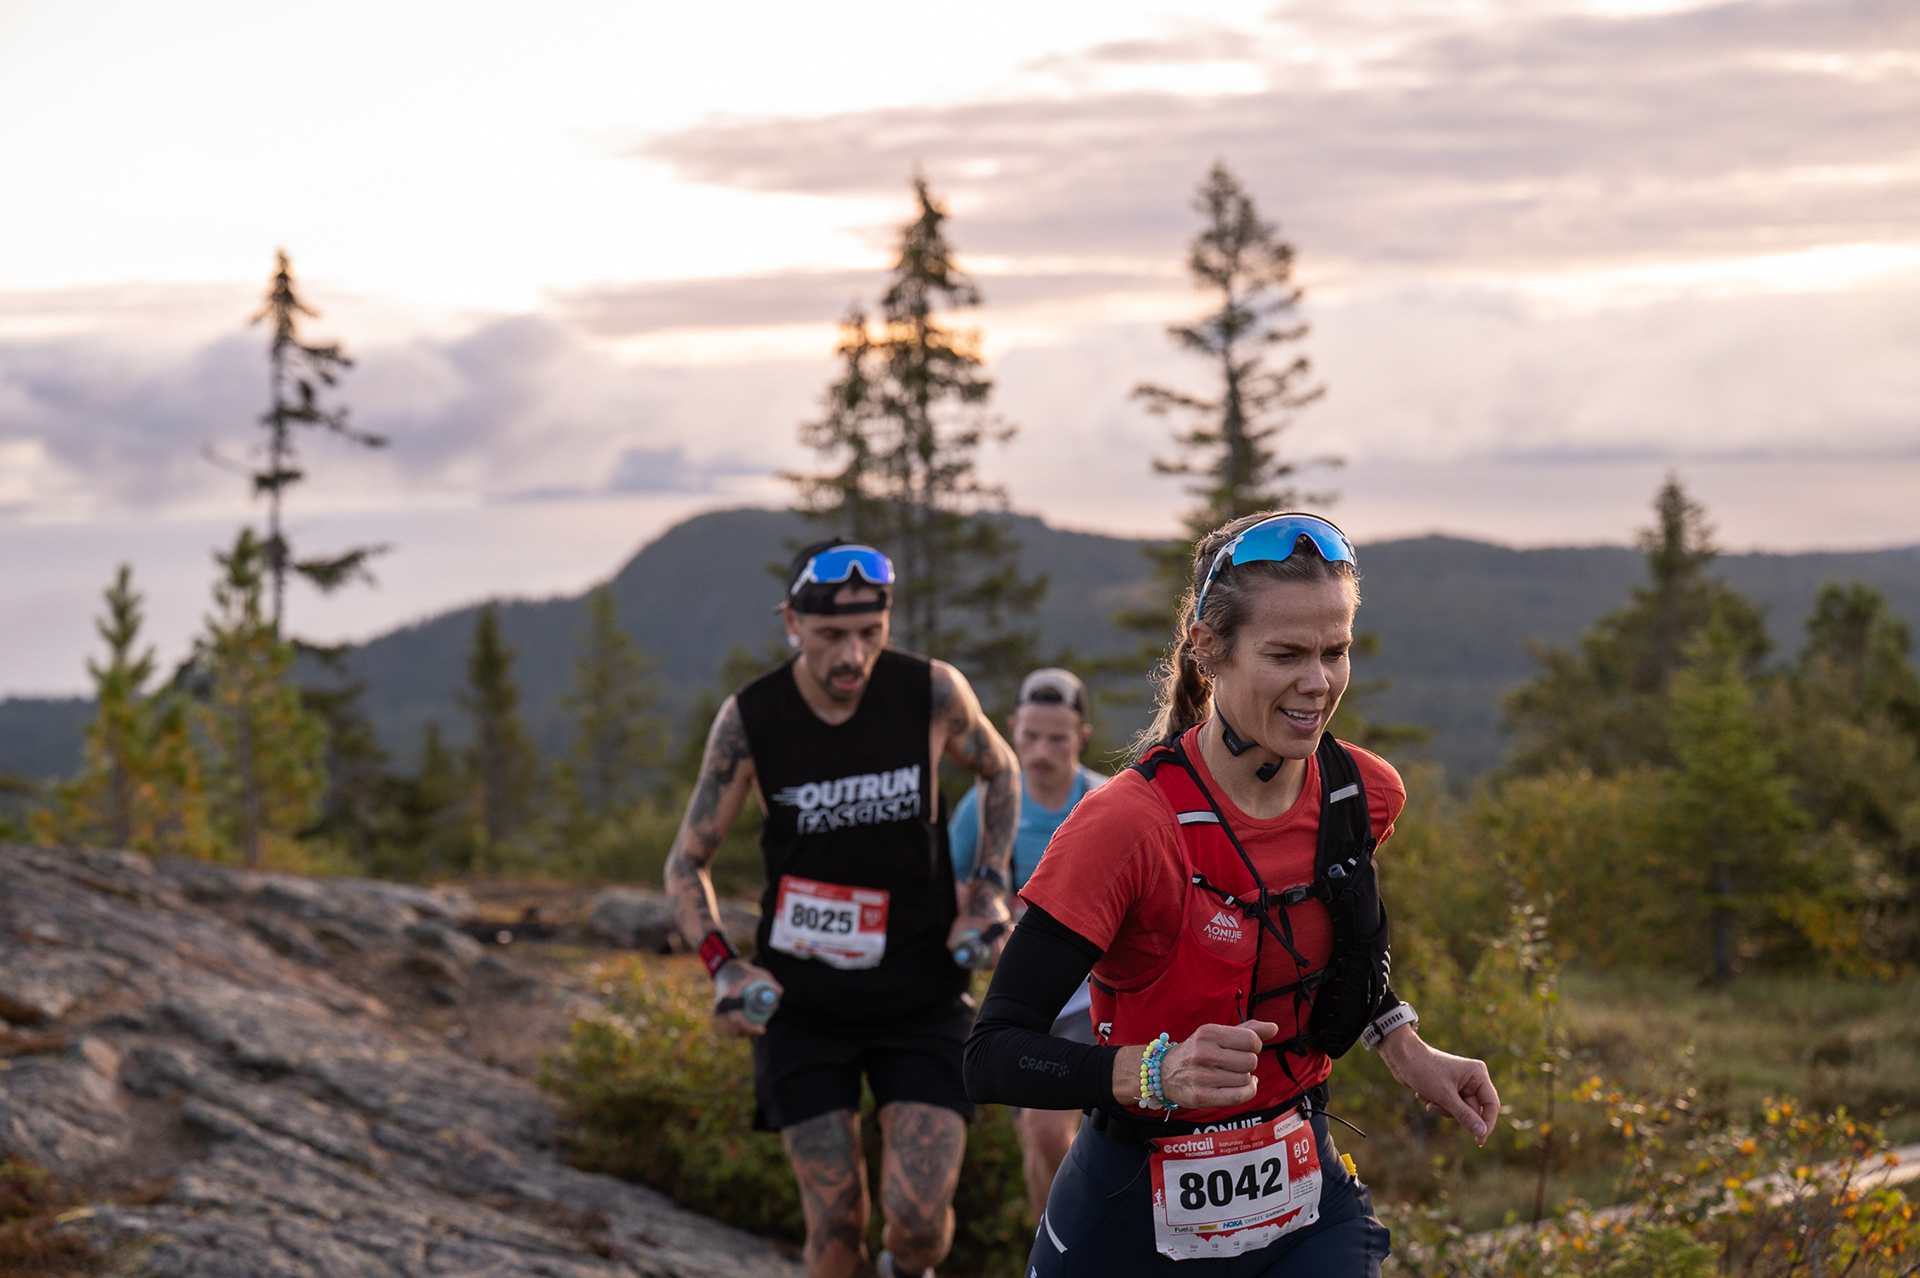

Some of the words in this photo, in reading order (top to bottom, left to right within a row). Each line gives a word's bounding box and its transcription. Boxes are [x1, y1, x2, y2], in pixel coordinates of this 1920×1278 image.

[797, 764, 921, 810] OUTRUN
[791, 902, 853, 934] 8025
[1018, 1055, 1060, 1074] CRAFT
[1163, 1137, 1214, 1153] ecotrail
[1218, 1140, 1244, 1148] Saturday
[1219, 1146, 1239, 1154] August
[1294, 1138, 1310, 1158] 80
[1298, 1156, 1308, 1164] KM
[1179, 1157, 1283, 1210] 8042
[1222, 1220, 1243, 1229] HOKA
[1265, 1208, 1286, 1218] GARMIN
